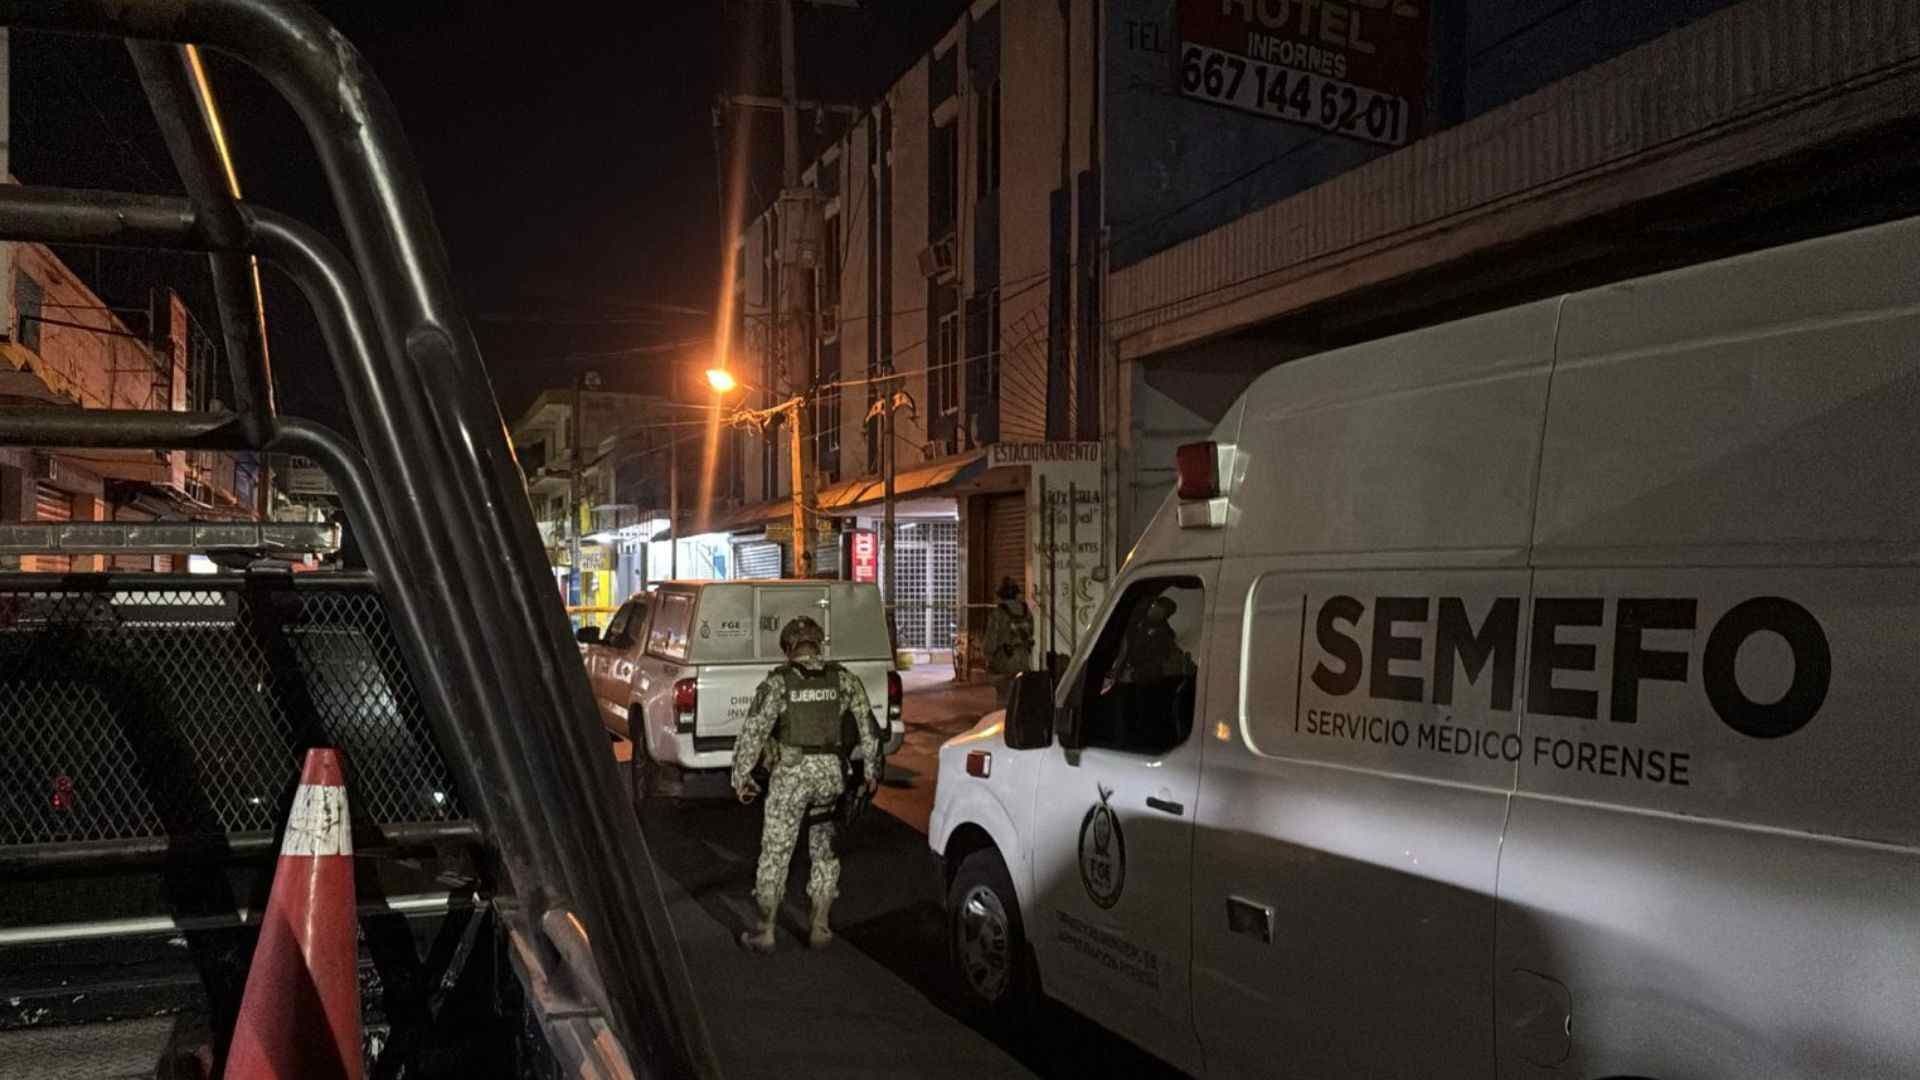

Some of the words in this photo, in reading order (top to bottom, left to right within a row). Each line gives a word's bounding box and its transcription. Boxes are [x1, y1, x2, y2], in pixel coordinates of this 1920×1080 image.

[1181, 46, 1247, 100] 667
[1254, 66, 1312, 118] 144
[993, 441, 1099, 463] ESTACIONAMIENTO
[1312, 595, 1832, 739] SEMEFO
[1307, 708, 1410, 747] SERVICIO
[1416, 715, 1523, 762] MÉDICO
[1533, 737, 1691, 786] FORENSE
